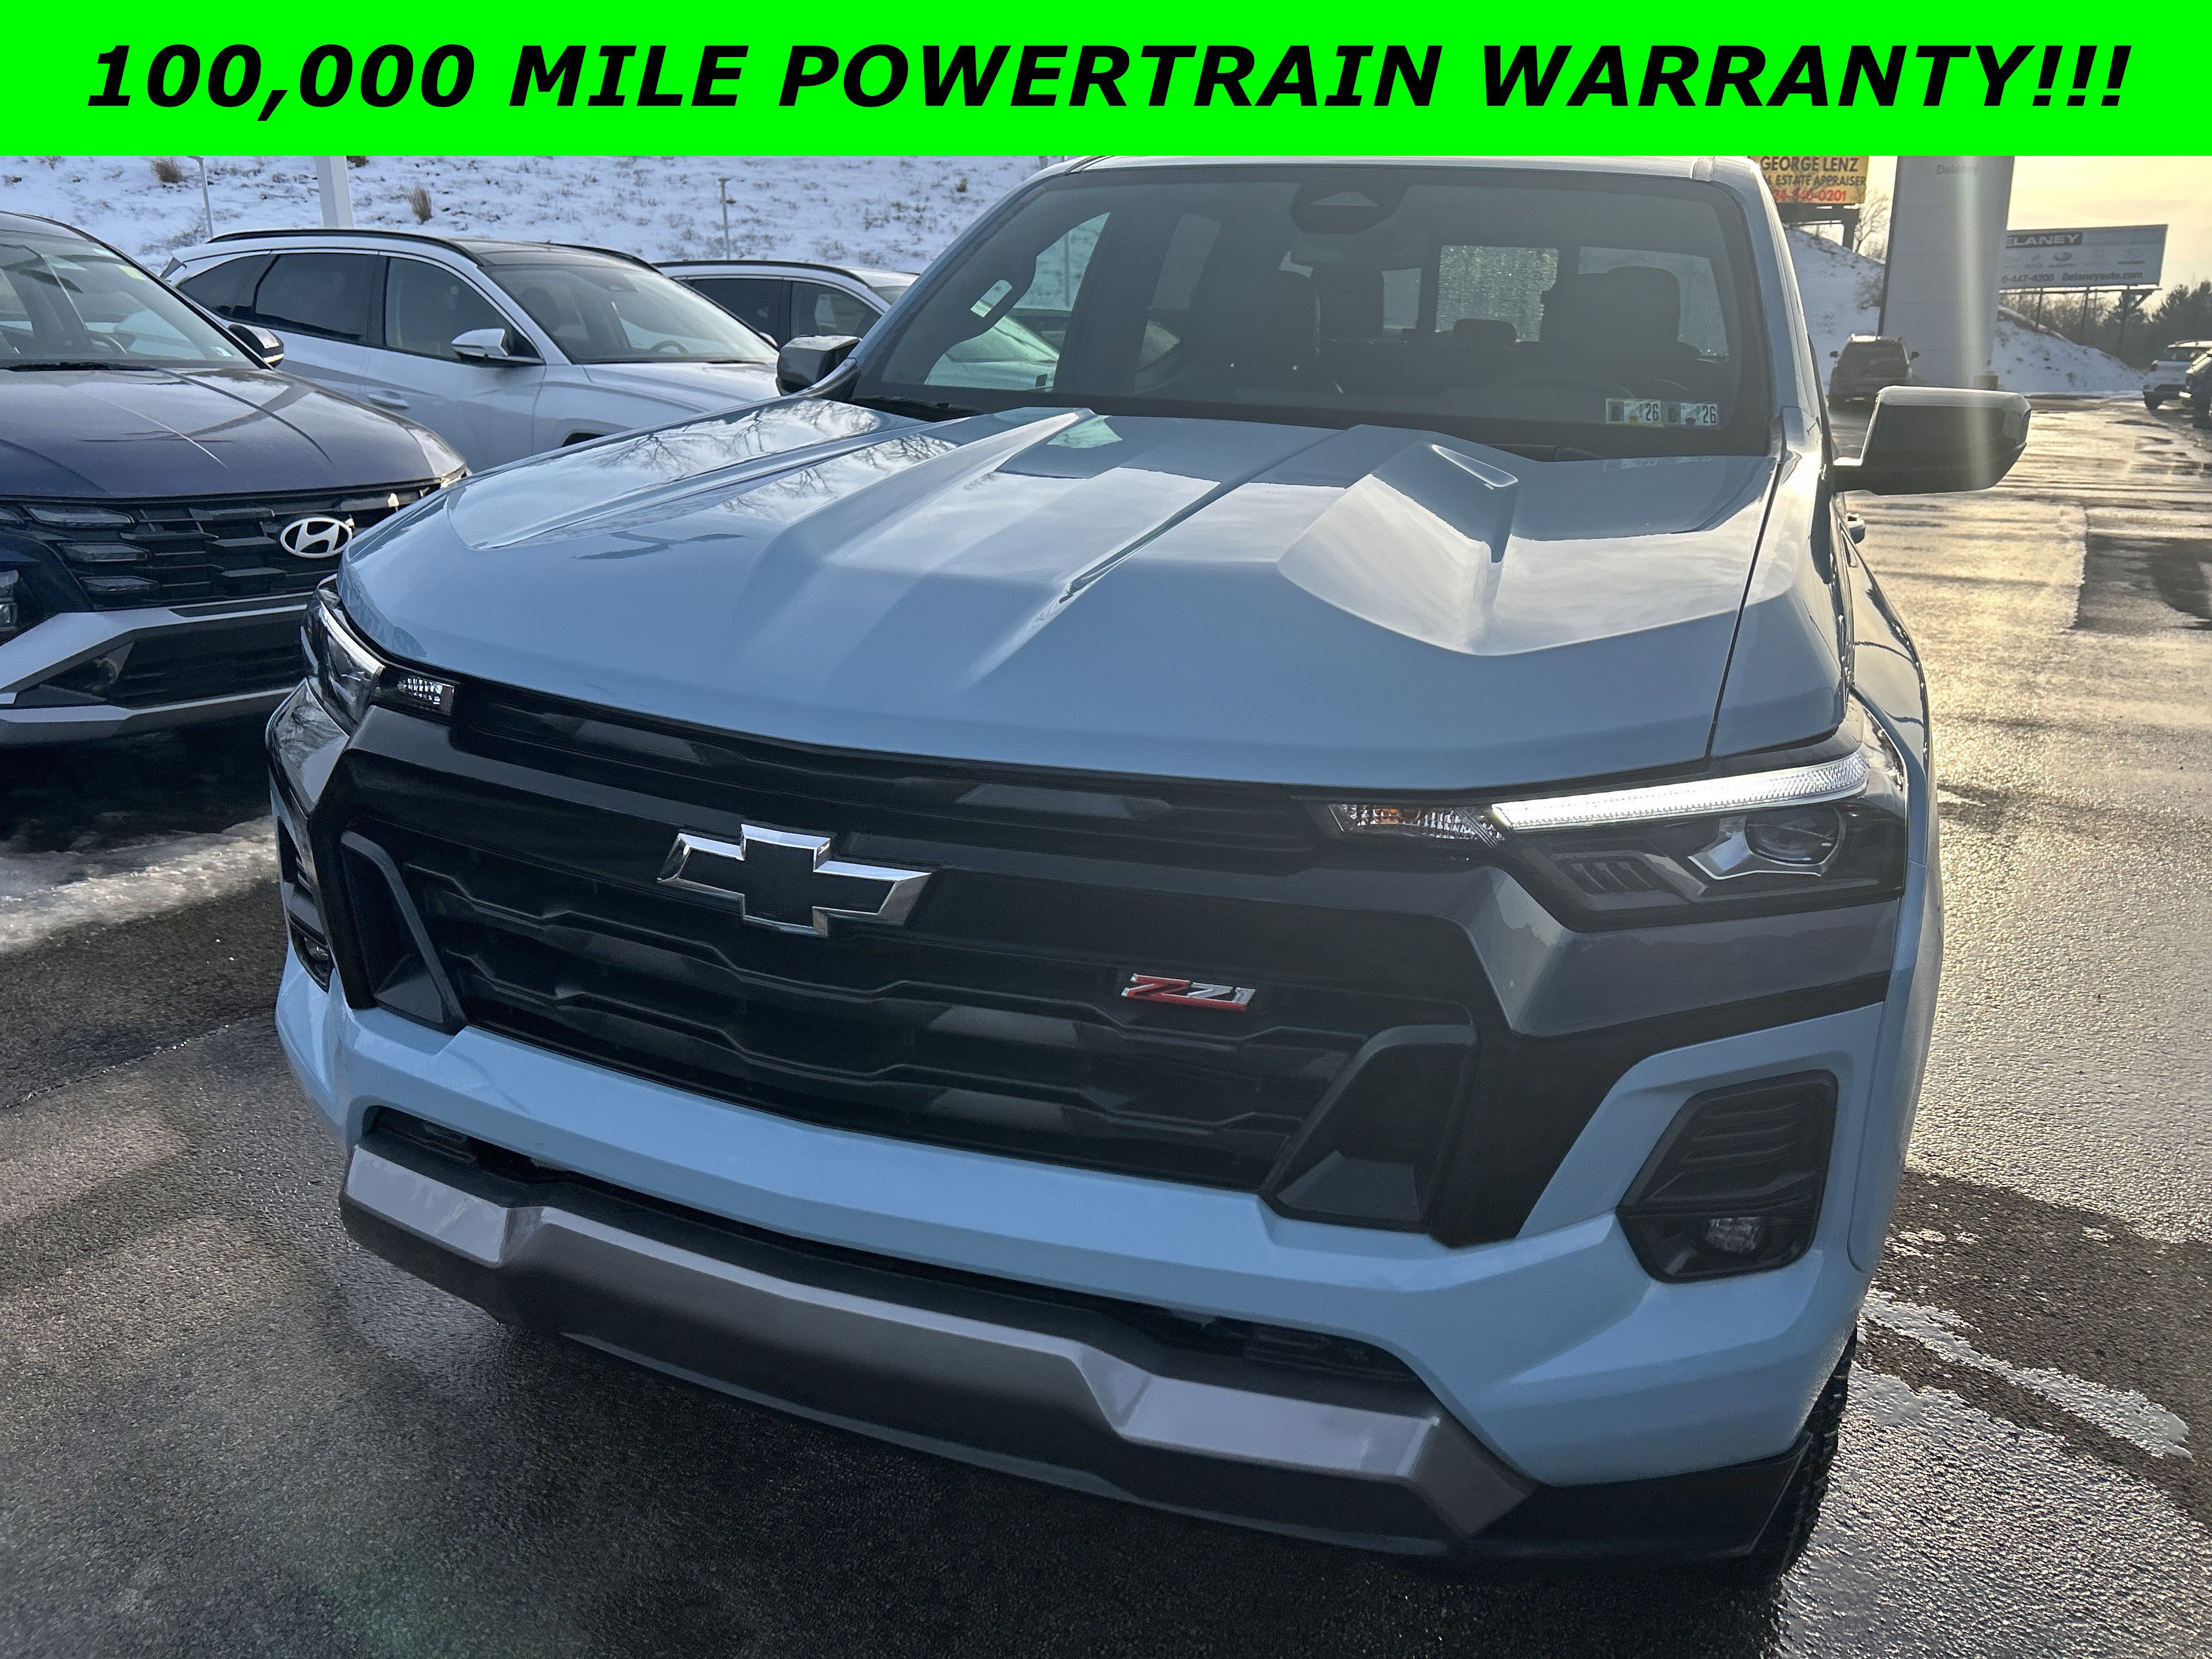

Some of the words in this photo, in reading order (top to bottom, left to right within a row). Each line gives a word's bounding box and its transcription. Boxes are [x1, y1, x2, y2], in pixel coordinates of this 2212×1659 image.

[1759, 156, 1819, 172] GEORGE
[1823, 157, 1859, 172] LENZ
[1775, 175, 1811, 186] ESTATE
[1813, 176, 1866, 187] APPRAISER
[2005, 234, 2079, 246] ELANEY
[1645, 403, 1659, 421] 26
[1702, 405, 1717, 424] 26
